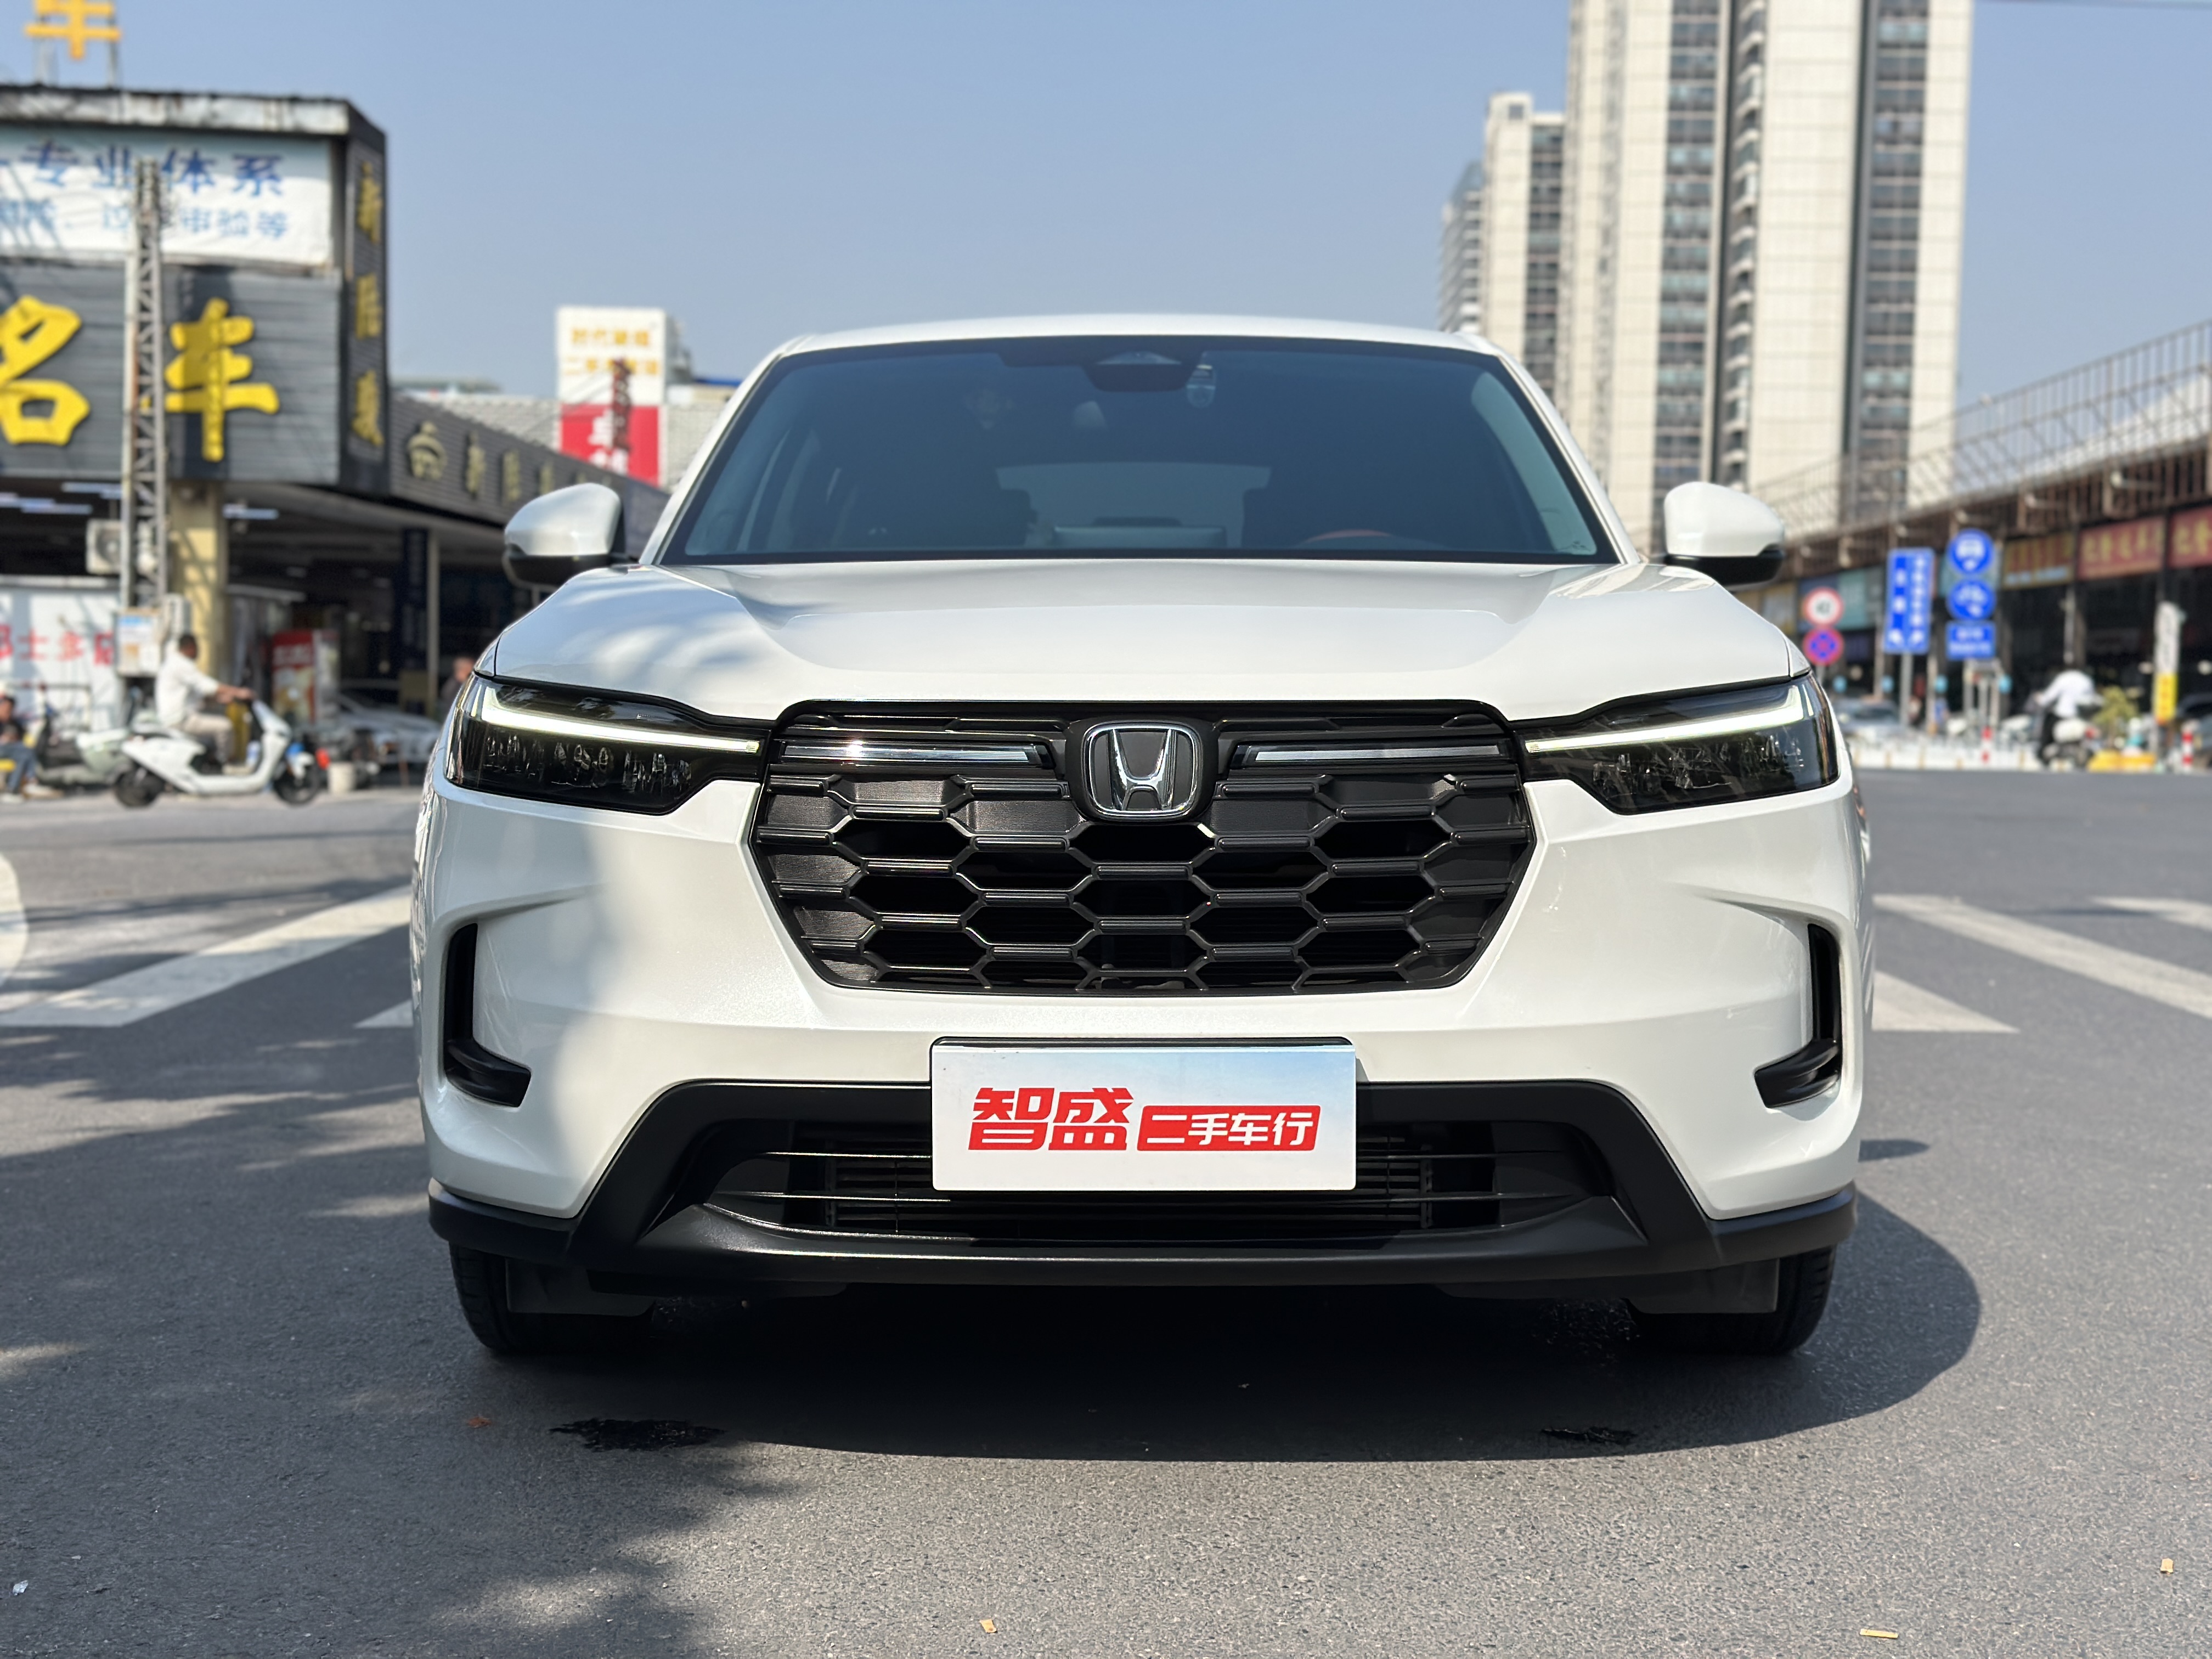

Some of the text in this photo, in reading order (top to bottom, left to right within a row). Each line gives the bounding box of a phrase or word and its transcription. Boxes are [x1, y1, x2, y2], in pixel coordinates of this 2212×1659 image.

[968, 1087, 1314, 1151] 智盛 二手车行
